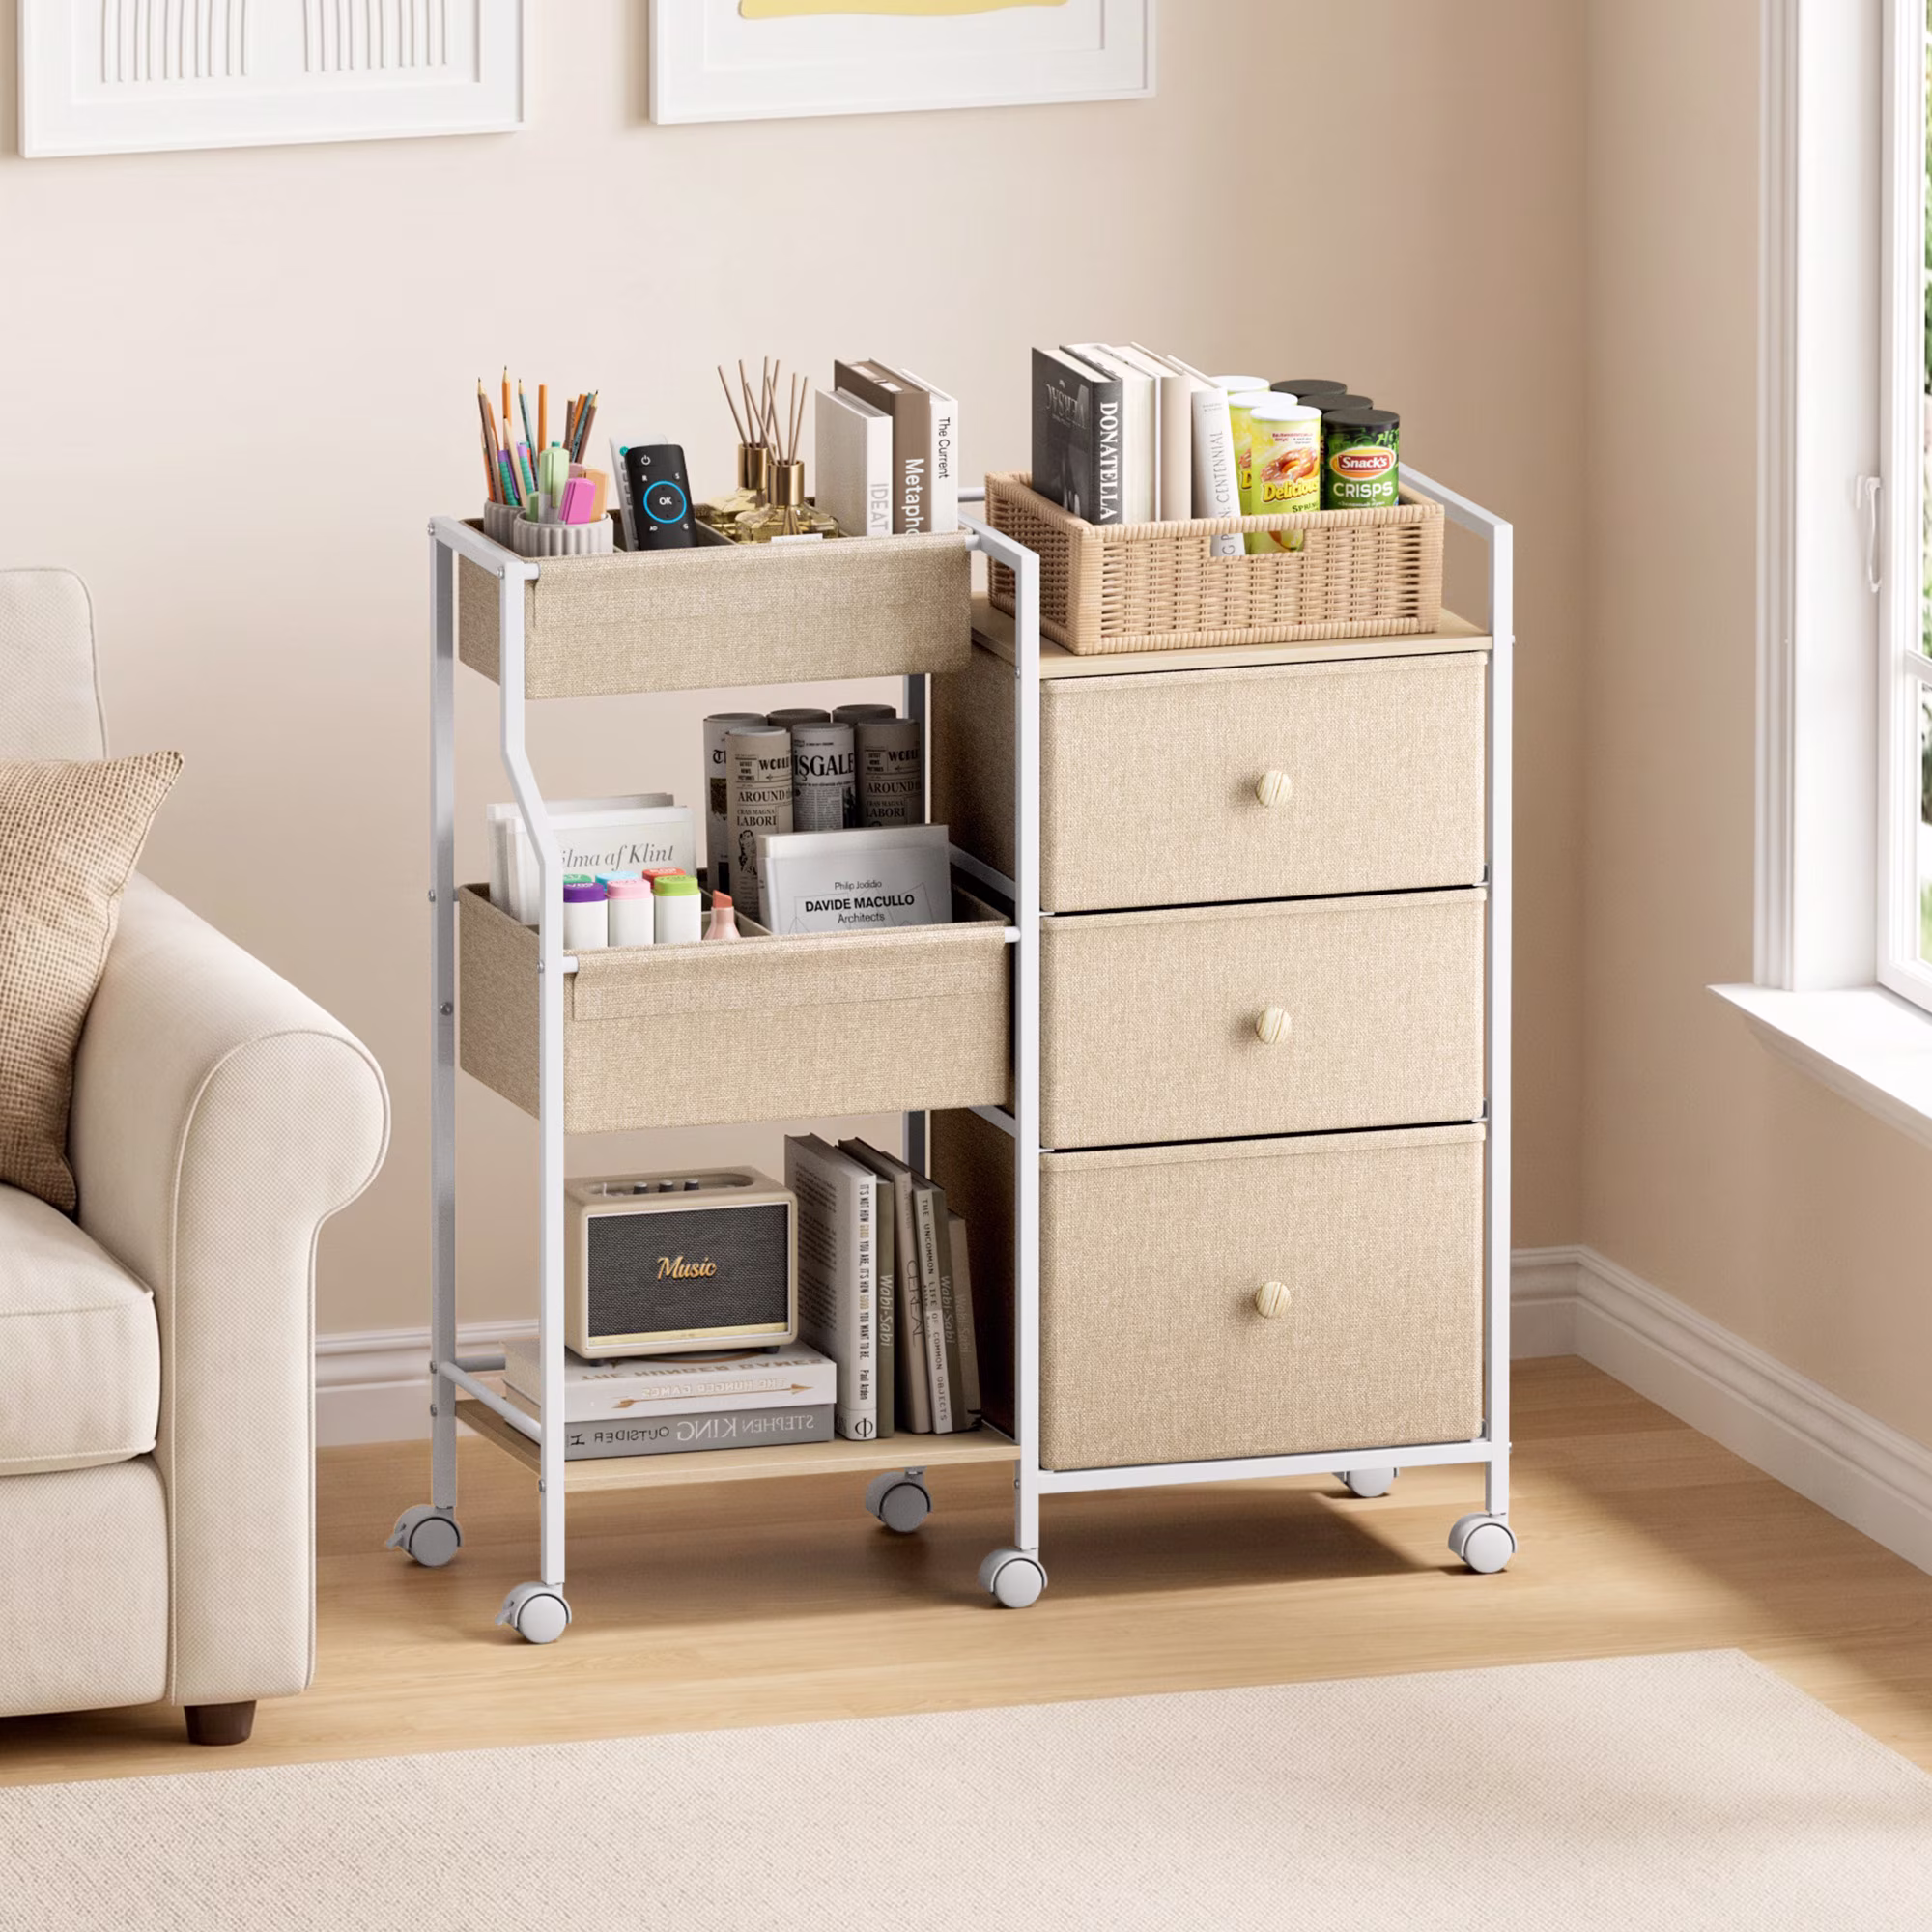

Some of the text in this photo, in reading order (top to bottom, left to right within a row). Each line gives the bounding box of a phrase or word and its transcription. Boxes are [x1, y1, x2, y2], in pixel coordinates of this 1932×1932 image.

[938, 416, 951, 479] The Current
[1099, 401, 1119, 521] DONATELLA
[1210, 431, 1231, 504] CENTENNIAL
[1340, 455, 1389, 469] Snack's
[1261, 481, 1319, 503] Delicious
[1333, 480, 1393, 499] CRISPS
[659, 497, 673, 505] OK
[869, 483, 890, 531] IDEAT
[737, 789, 785, 803] AROUND
[867, 781, 914, 794] AROUND
[604, 844, 628, 871] af
[628, 842, 674, 864] Klint
[834, 879, 883, 892] Philip Jodidio
[805, 894, 915, 913] DAVIDE MACULLO
[837, 912, 886, 924] Architects
[922, 1199, 930, 1216] THE
[923, 1223, 935, 1275] UNCOMMON
[656, 1256, 718, 1281] Music
[928, 1281, 938, 1307] LIFE
[931, 1312, 939, 1323] OF
[932, 1333, 943, 1371] COMMON
[936, 1376, 949, 1421] OBJECTS
